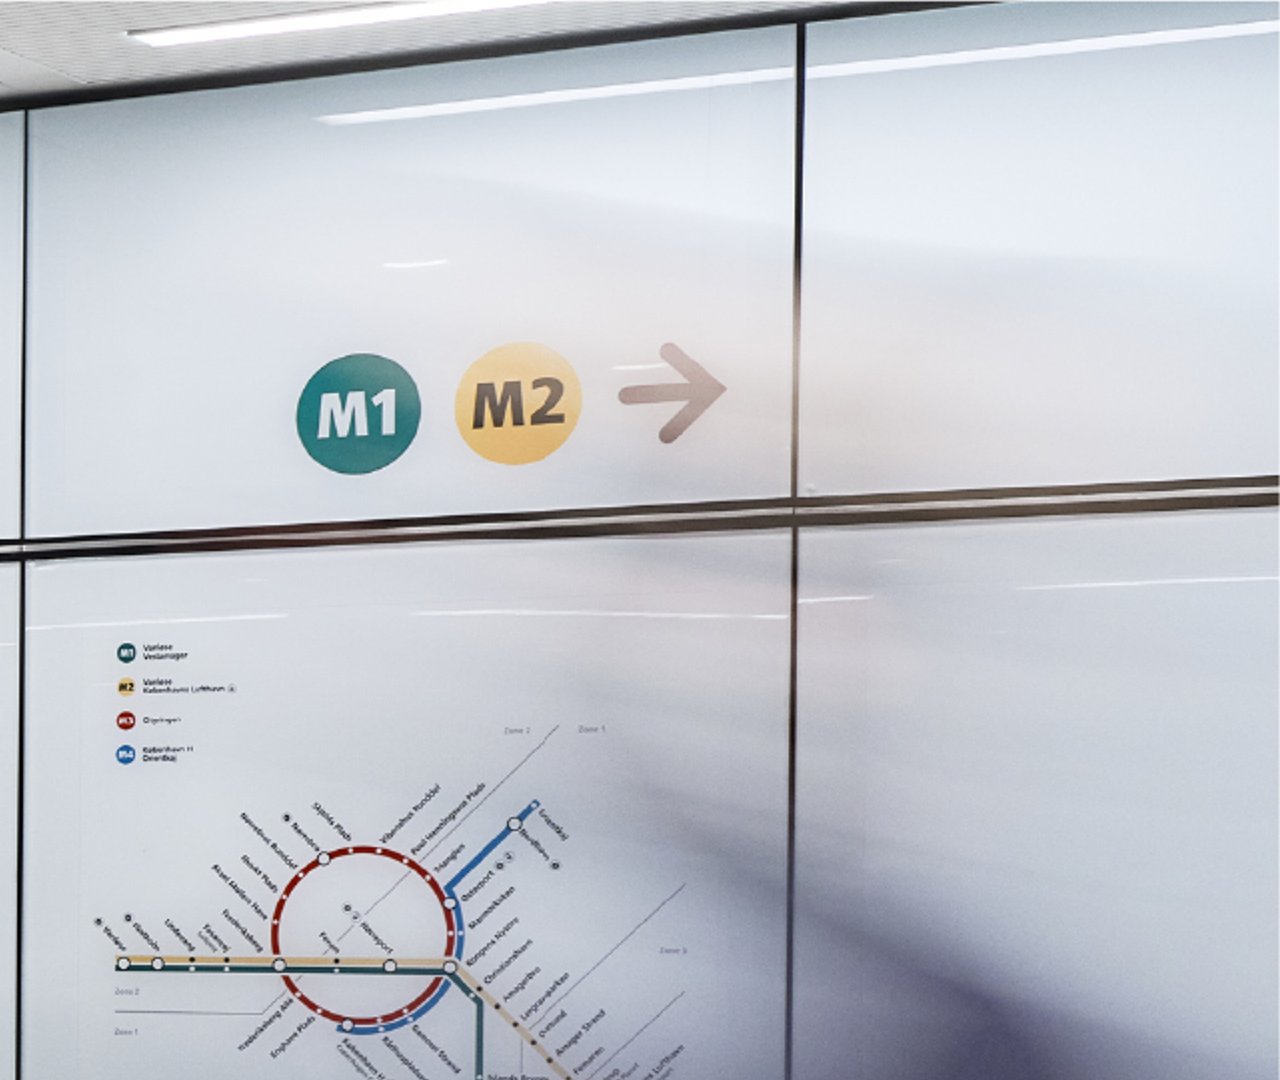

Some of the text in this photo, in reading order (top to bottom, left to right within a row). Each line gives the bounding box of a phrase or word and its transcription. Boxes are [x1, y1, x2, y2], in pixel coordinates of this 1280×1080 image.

[317, 376, 566, 440] M1 M2
[118, 682, 135, 692] M2
